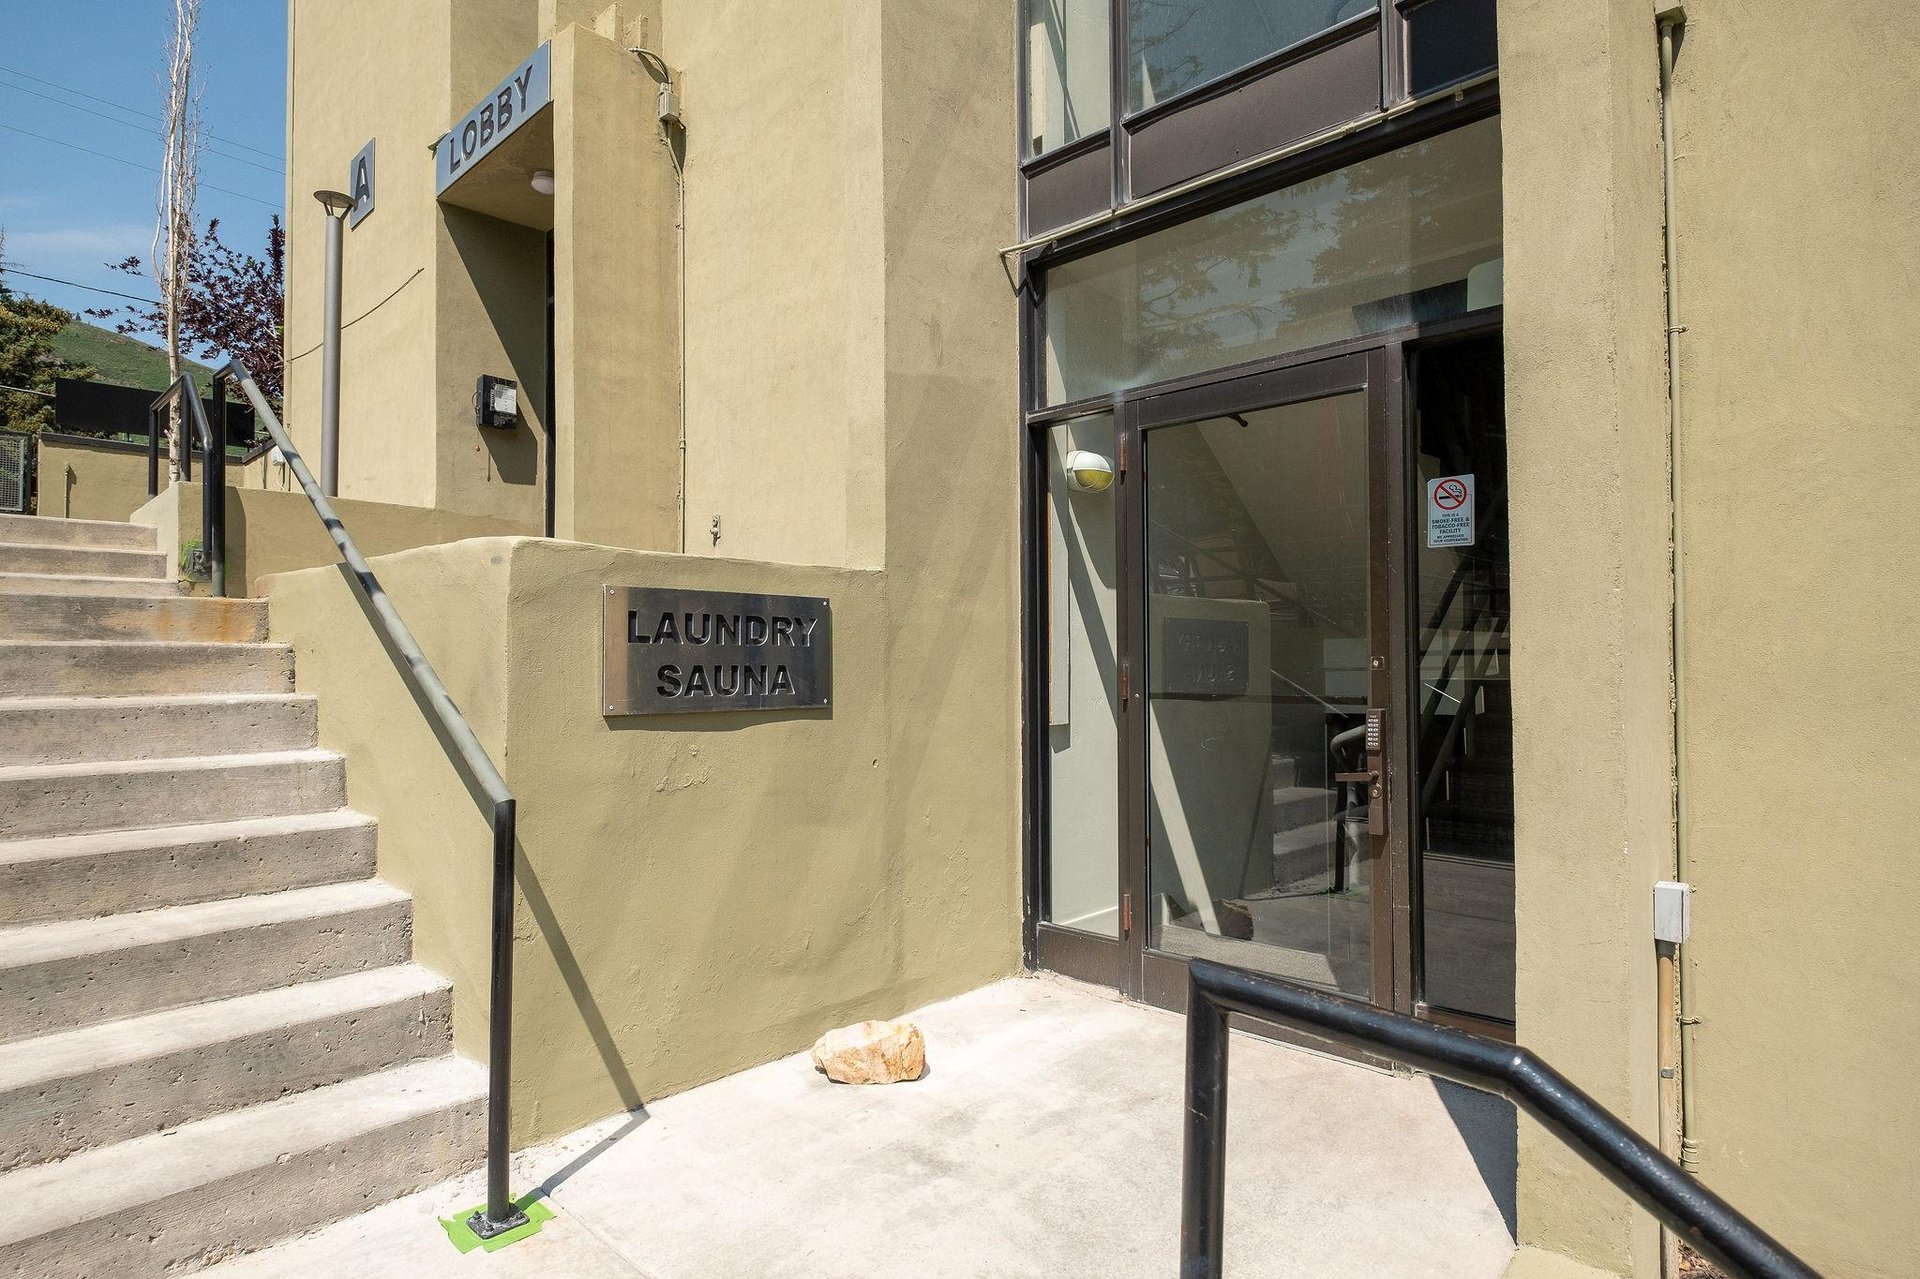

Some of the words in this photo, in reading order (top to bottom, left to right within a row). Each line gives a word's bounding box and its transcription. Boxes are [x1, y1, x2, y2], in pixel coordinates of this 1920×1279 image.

[449, 64, 533, 176] LOBBY
[353, 156, 370, 213] A
[627, 610, 818, 647] LAUNDRY
[656, 664, 796, 698] SAUNA
